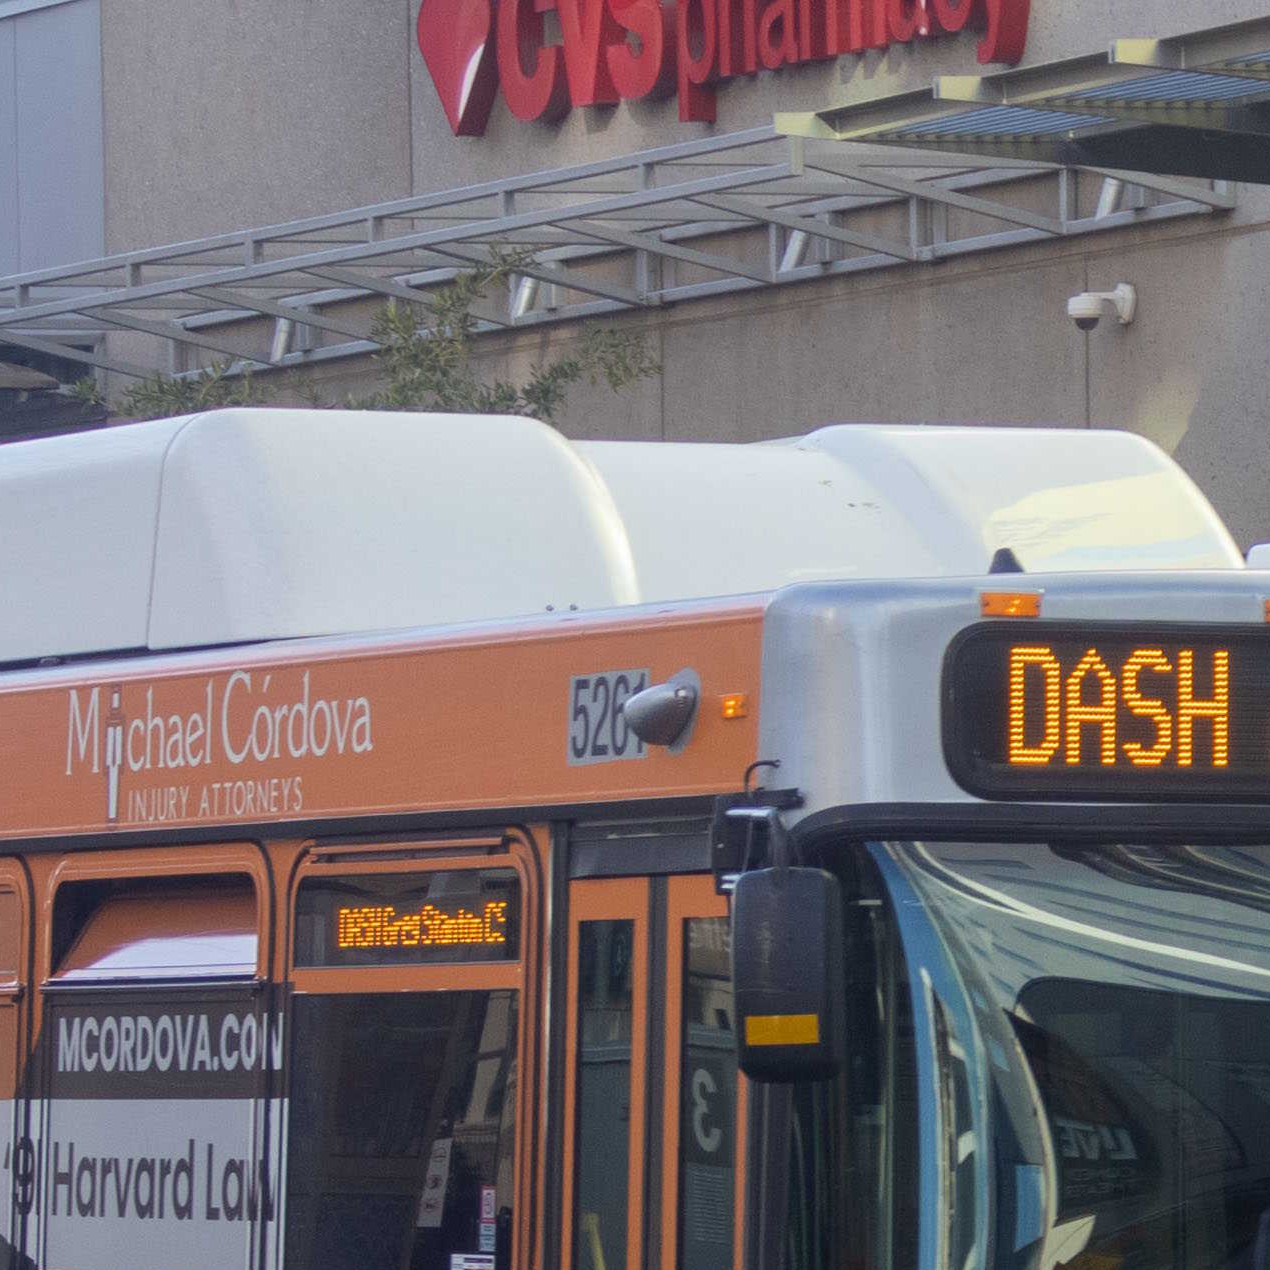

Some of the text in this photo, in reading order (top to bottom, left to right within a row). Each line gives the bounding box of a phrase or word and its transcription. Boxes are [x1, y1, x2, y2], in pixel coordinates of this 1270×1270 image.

[65, 670, 373, 797] Michael Córdova
[1008, 646, 1229, 766] DASH
[129, 776, 303, 822] INJURY ATTORNEYS
[52, 1139, 196, 1220] Harvard
